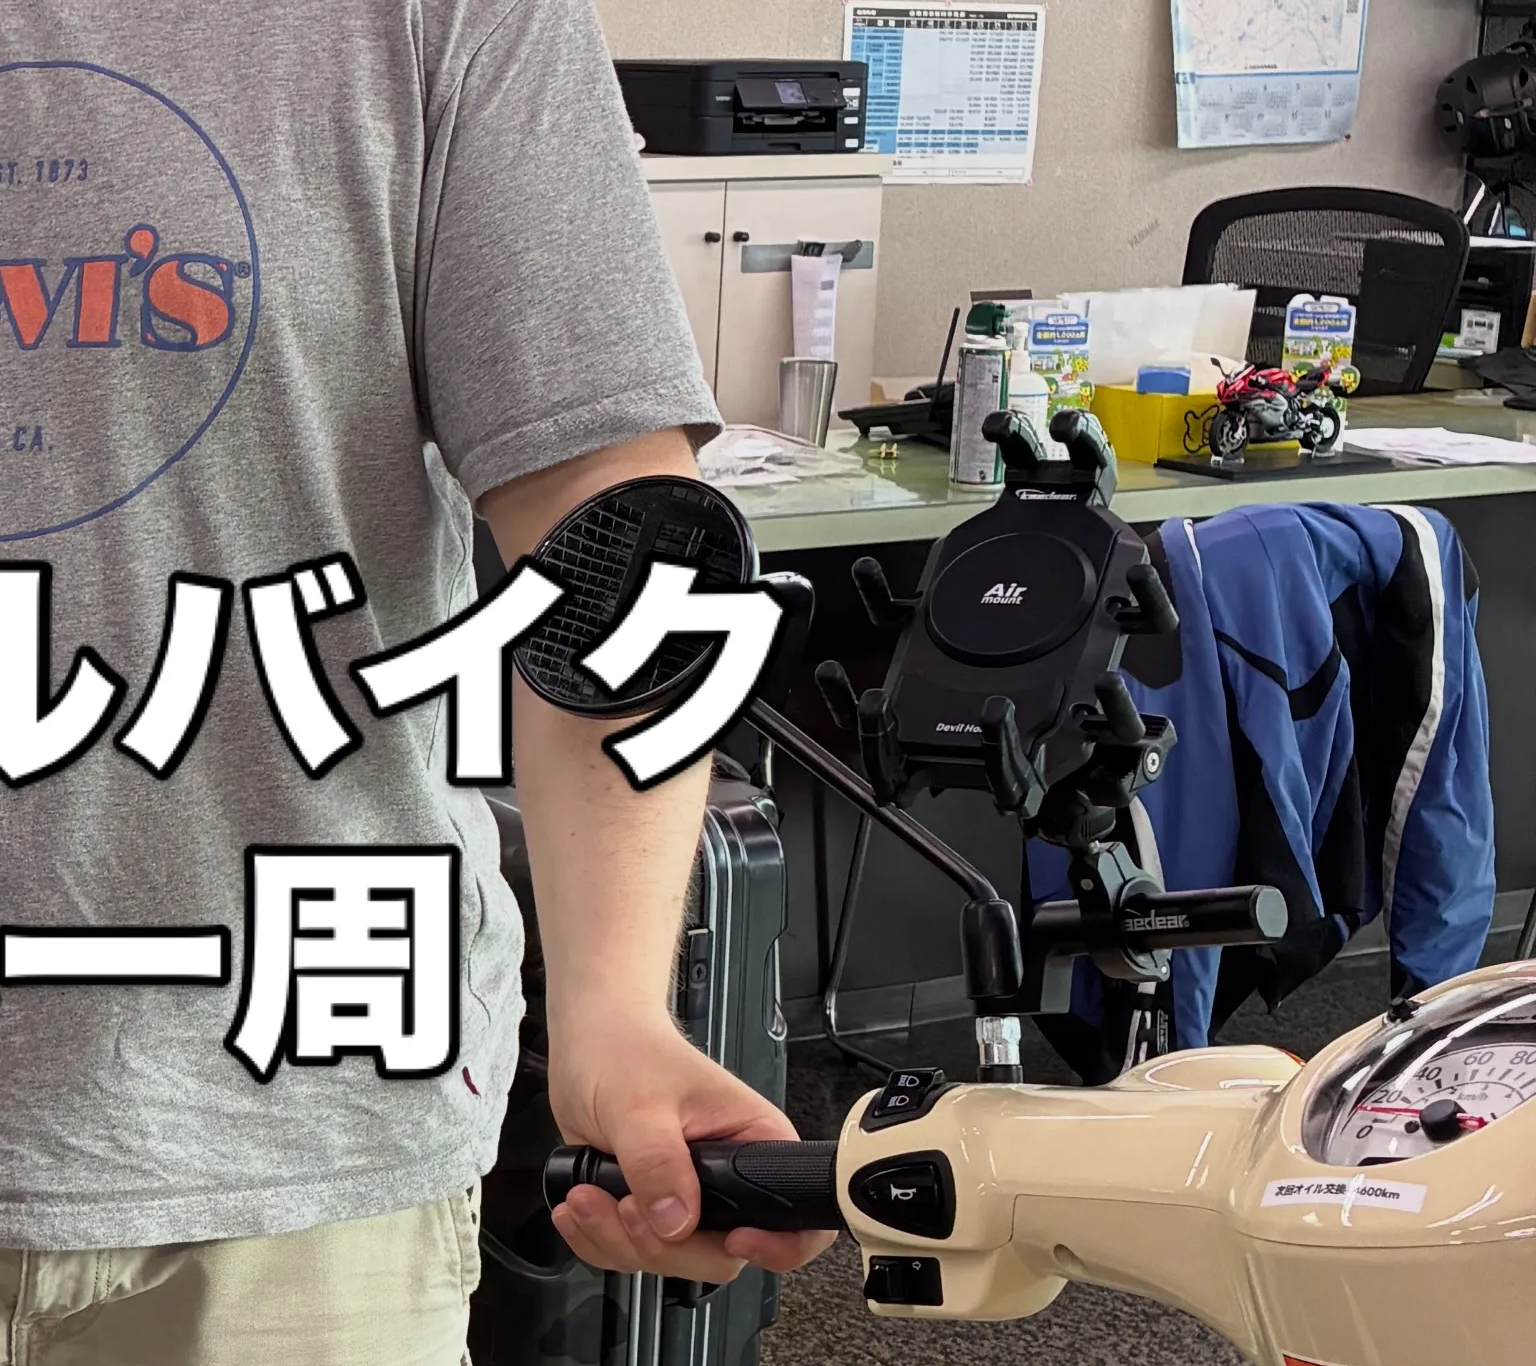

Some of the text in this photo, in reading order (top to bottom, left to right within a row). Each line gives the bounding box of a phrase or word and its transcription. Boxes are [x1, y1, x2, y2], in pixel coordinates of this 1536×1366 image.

[36, 160, 90, 184] 1873
[13, 427, 54, 453] CA.
[984, 583, 1028, 597] Air
[980, 596, 1024, 605] mount
[936, 722, 982, 733] Devil Ho
[1356, 1050, 1536, 1139] 0 20 40 60 80
[1457, 1089, 1489, 1102] km/h
